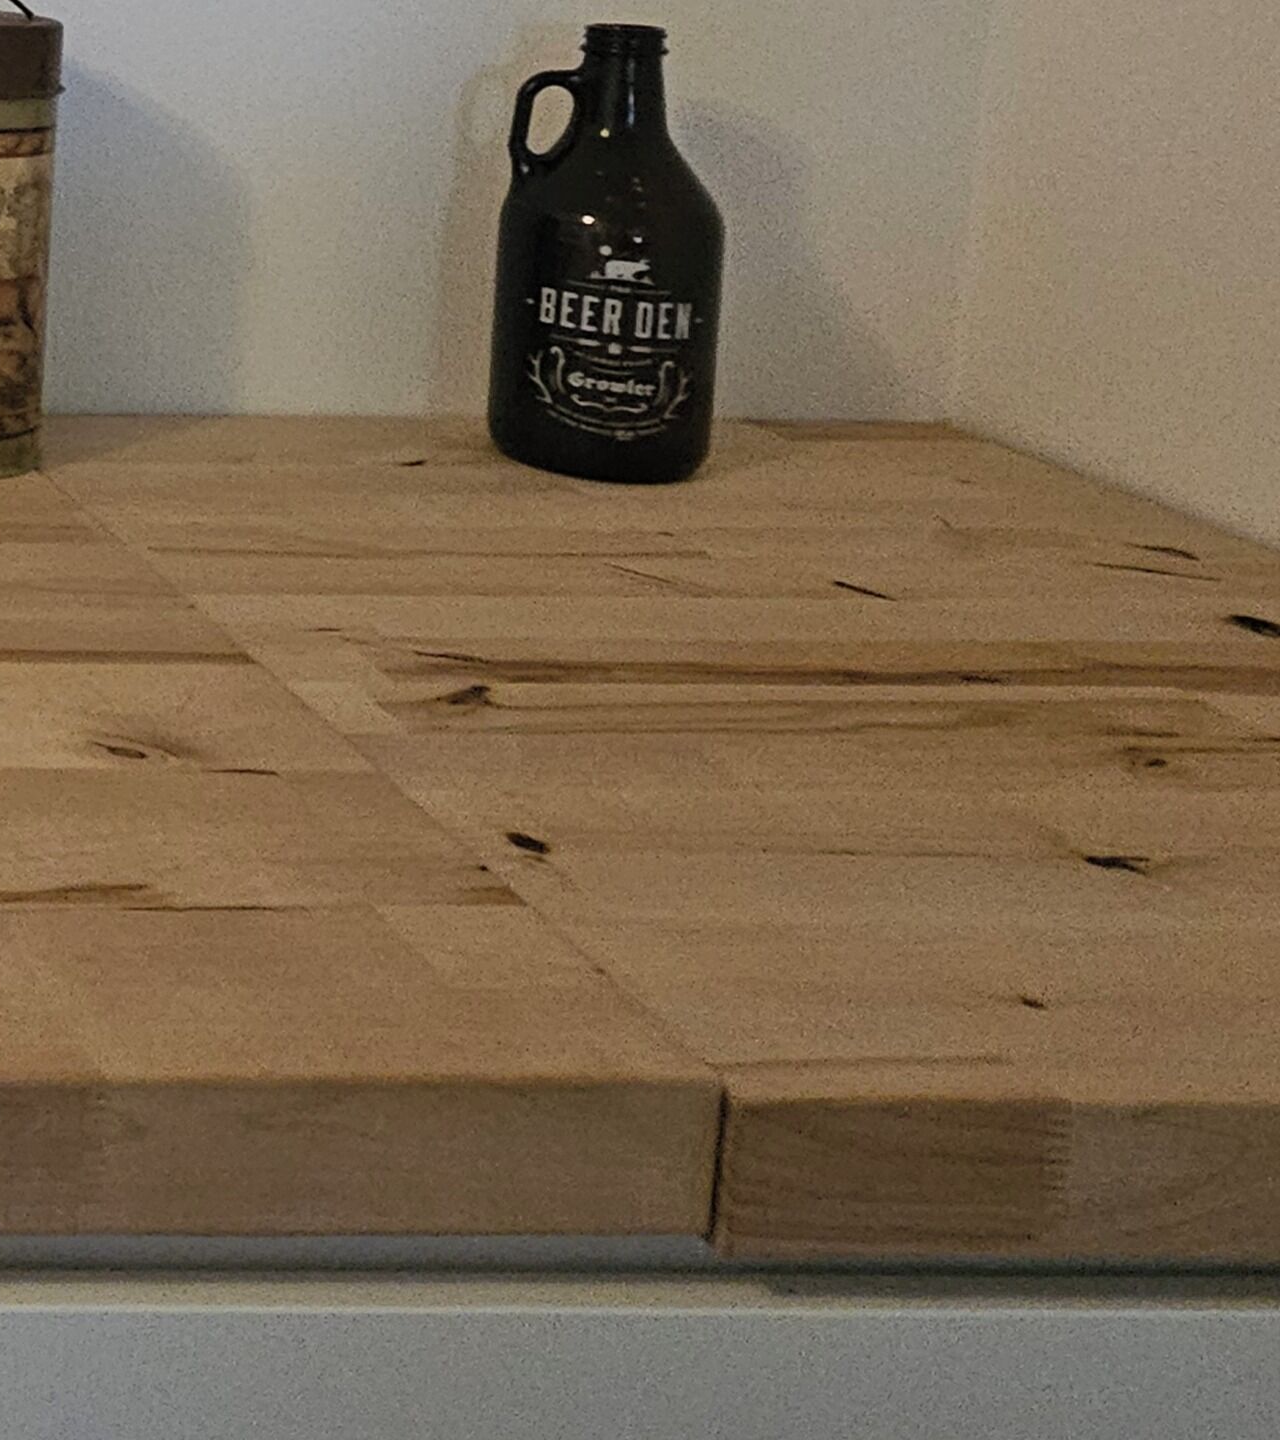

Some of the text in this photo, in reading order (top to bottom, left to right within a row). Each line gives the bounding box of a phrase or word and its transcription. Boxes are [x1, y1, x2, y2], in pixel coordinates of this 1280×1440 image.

[539, 286, 692, 340] BEER DEN
[567, 371, 657, 396] Growler
